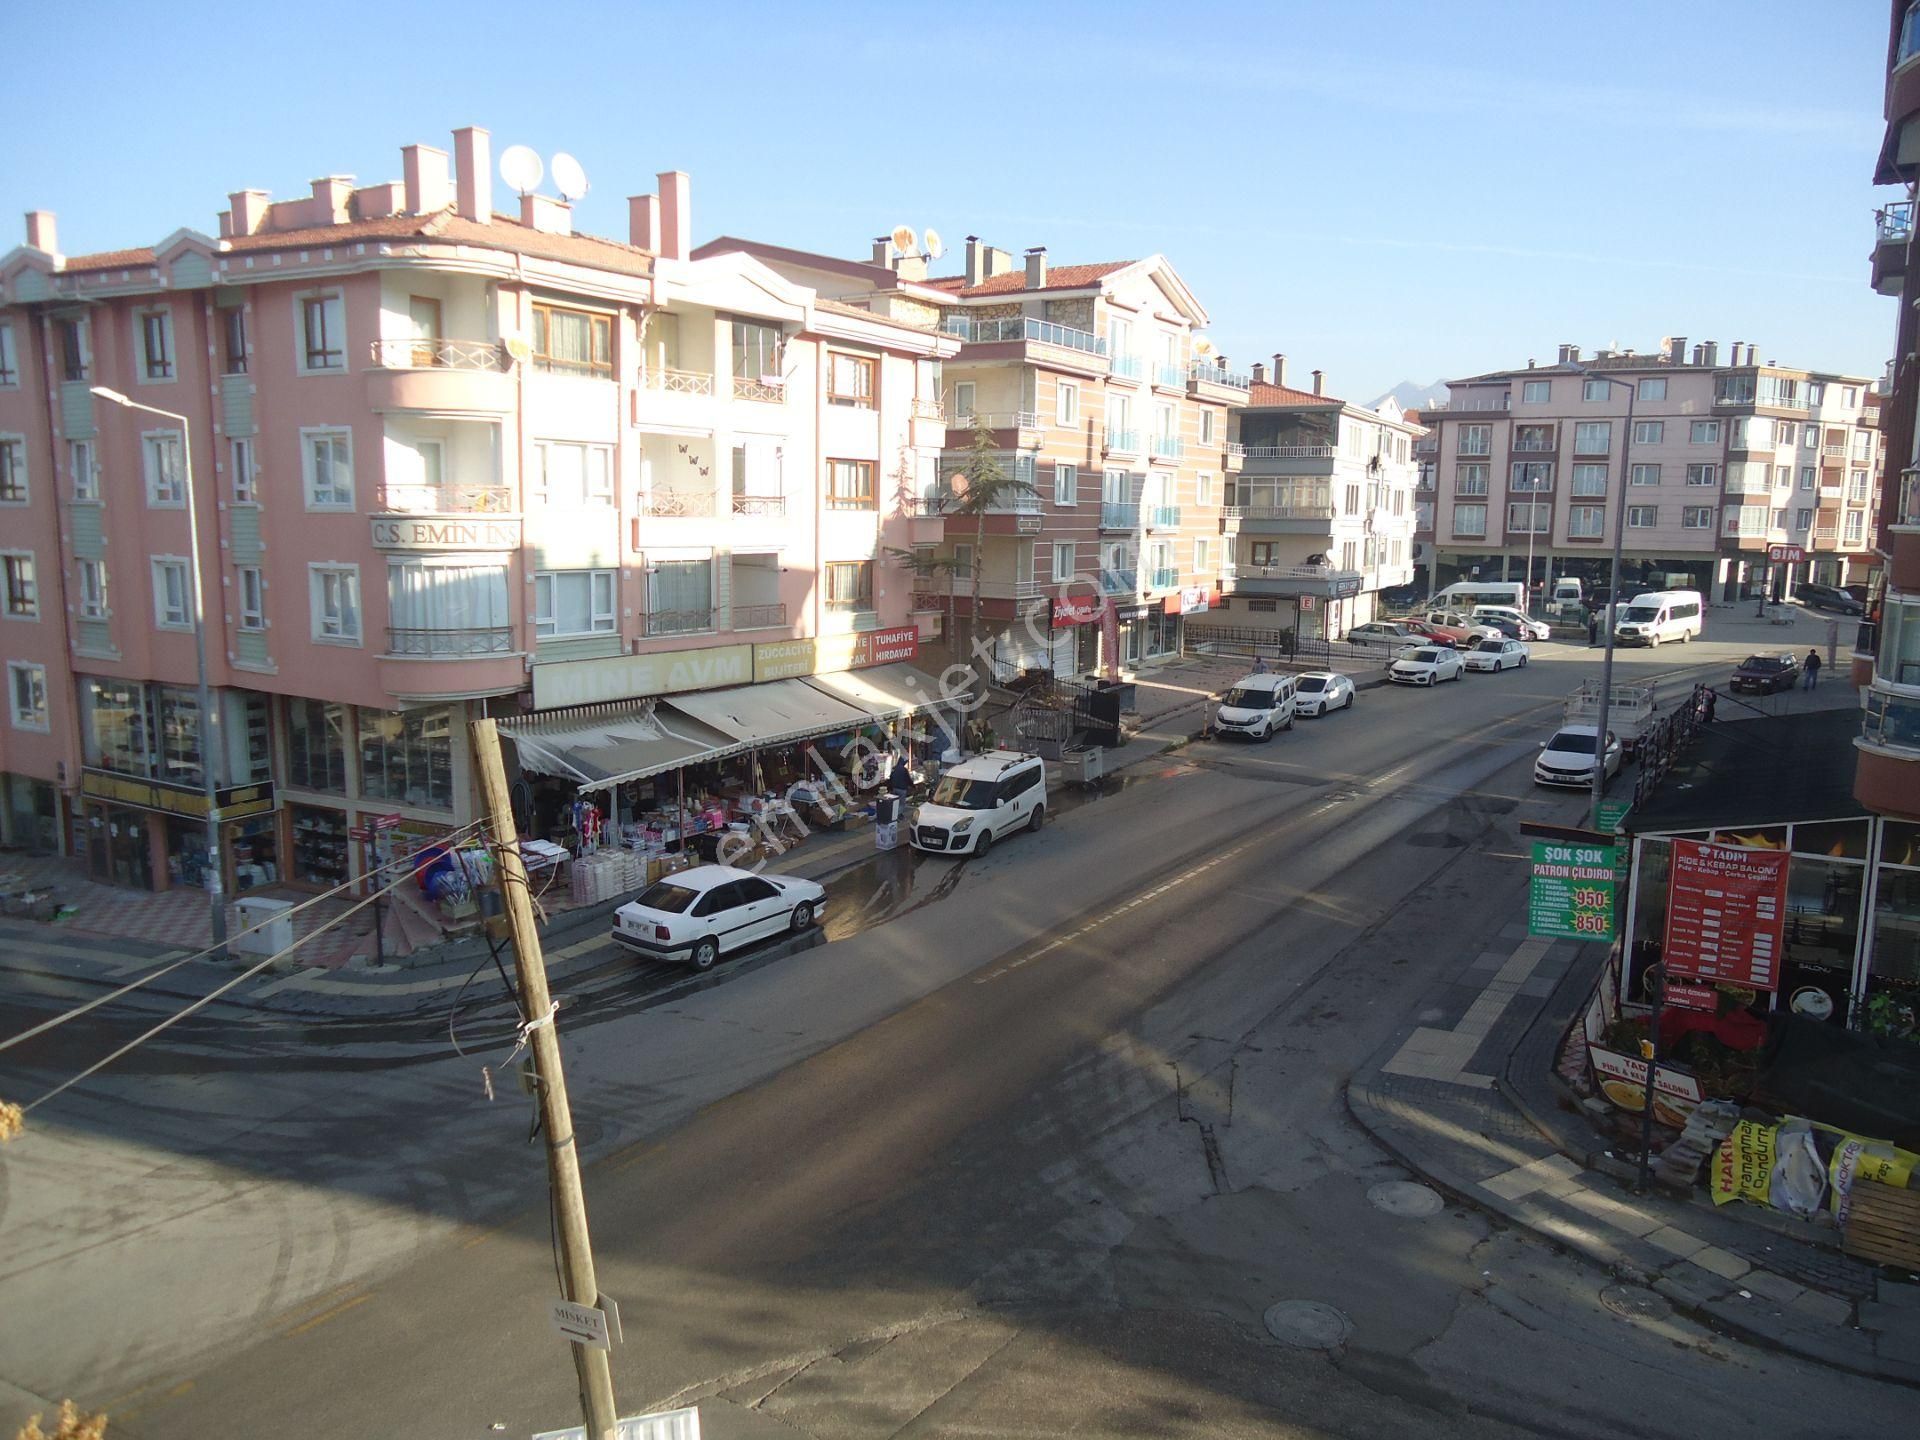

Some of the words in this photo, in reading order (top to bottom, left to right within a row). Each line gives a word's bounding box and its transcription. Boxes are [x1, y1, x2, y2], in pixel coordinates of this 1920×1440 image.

[374, 524, 405, 543] C.S.
[411, 521, 477, 543] EMİN
[1771, 547, 1800, 560] BİM
[875, 631, 914, 646] TUHAFİYE
[875, 647, 913, 662] HIRDAVAT
[667, 655, 741, 689] AVM
[1544, 847, 1572, 863] ŞOK
[1575, 848, 1603, 866] ŞOK
[1712, 849, 1748, 862] TADIM
[1533, 863, 1569, 877] PATRON
[1571, 865, 1613, 880] ÇILDIRDI
[1707, 861, 1739, 871] KEBAP
[1740, 864, 1778, 875] SALONU
[1577, 890, 1604, 907] 950
[1576, 915, 1604, 931] 850
[1657, 1080, 1690, 1096] SALONU
